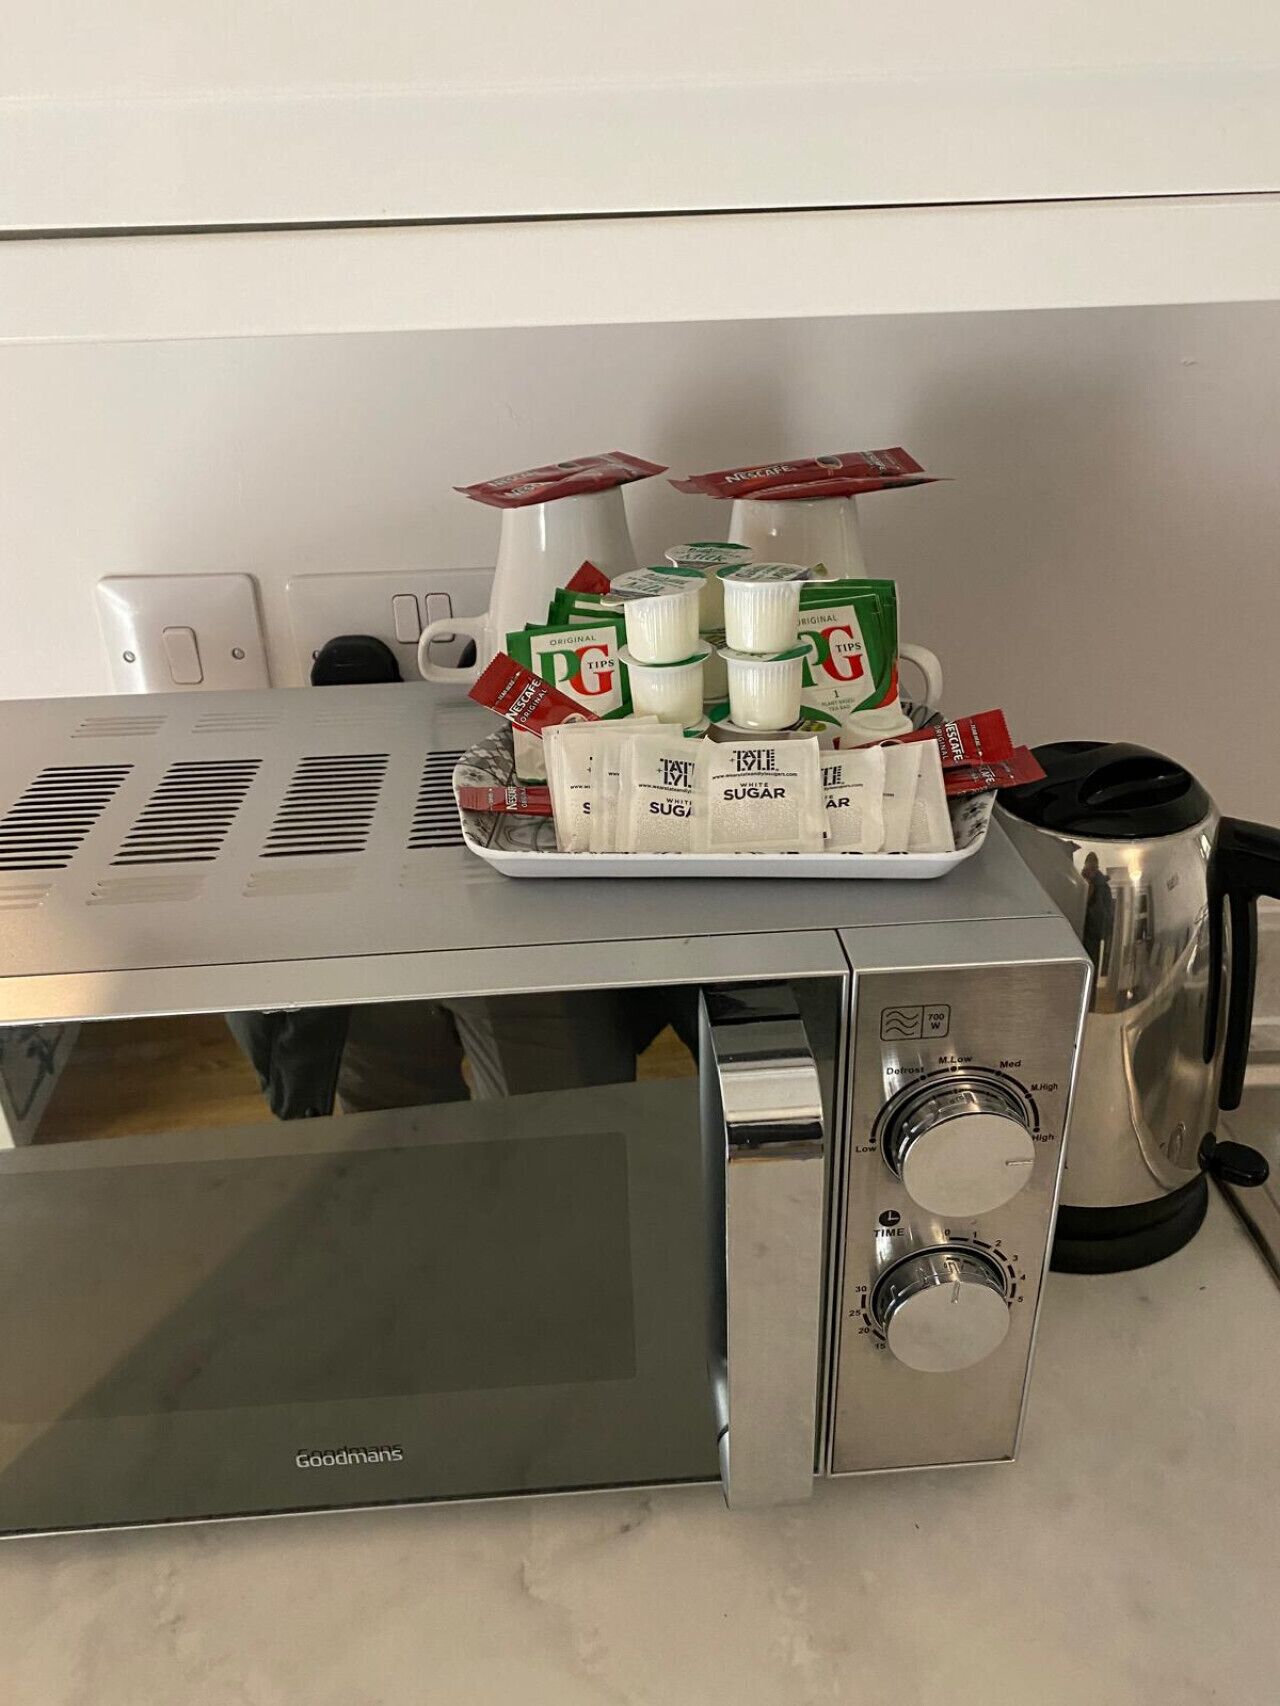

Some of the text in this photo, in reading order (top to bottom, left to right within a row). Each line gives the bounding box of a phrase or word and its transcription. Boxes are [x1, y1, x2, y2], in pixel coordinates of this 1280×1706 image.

[549, 635, 597, 646] ORIGINAL
[835, 642, 862, 653] TIPS
[797, 625, 865, 688] PG
[586, 658, 616, 670] TIPS
[535, 644, 615, 697] PG
[834, 689, 839, 698] 1
[520, 689, 548, 723] ORIGINAL
[733, 749, 775, 760] TATE
[737, 759, 776, 772] LYLE
[723, 787, 786, 801] SUGAR
[928, 1012, 945, 1021] 700
[930, 1021, 941, 1030] W
[938, 1055, 973, 1063] M.Low
[1000, 1059, 1022, 1068] Med
[886, 1066, 924, 1075] Defrost
[1031, 1083, 1058, 1092] M.High
[1032, 1133, 1055, 1142] High
[855, 1145, 877, 1153] Low
[874, 1227, 905, 1237] TIME
[944, 1228, 951, 1236] 0
[973, 1230, 978, 1238] 1
[1012, 1254, 1019, 1262] 3
[1019, 1273, 1026, 1281] 4
[849, 1309, 861, 1317] 25
[295, 1450, 403, 1468] Goodmans
